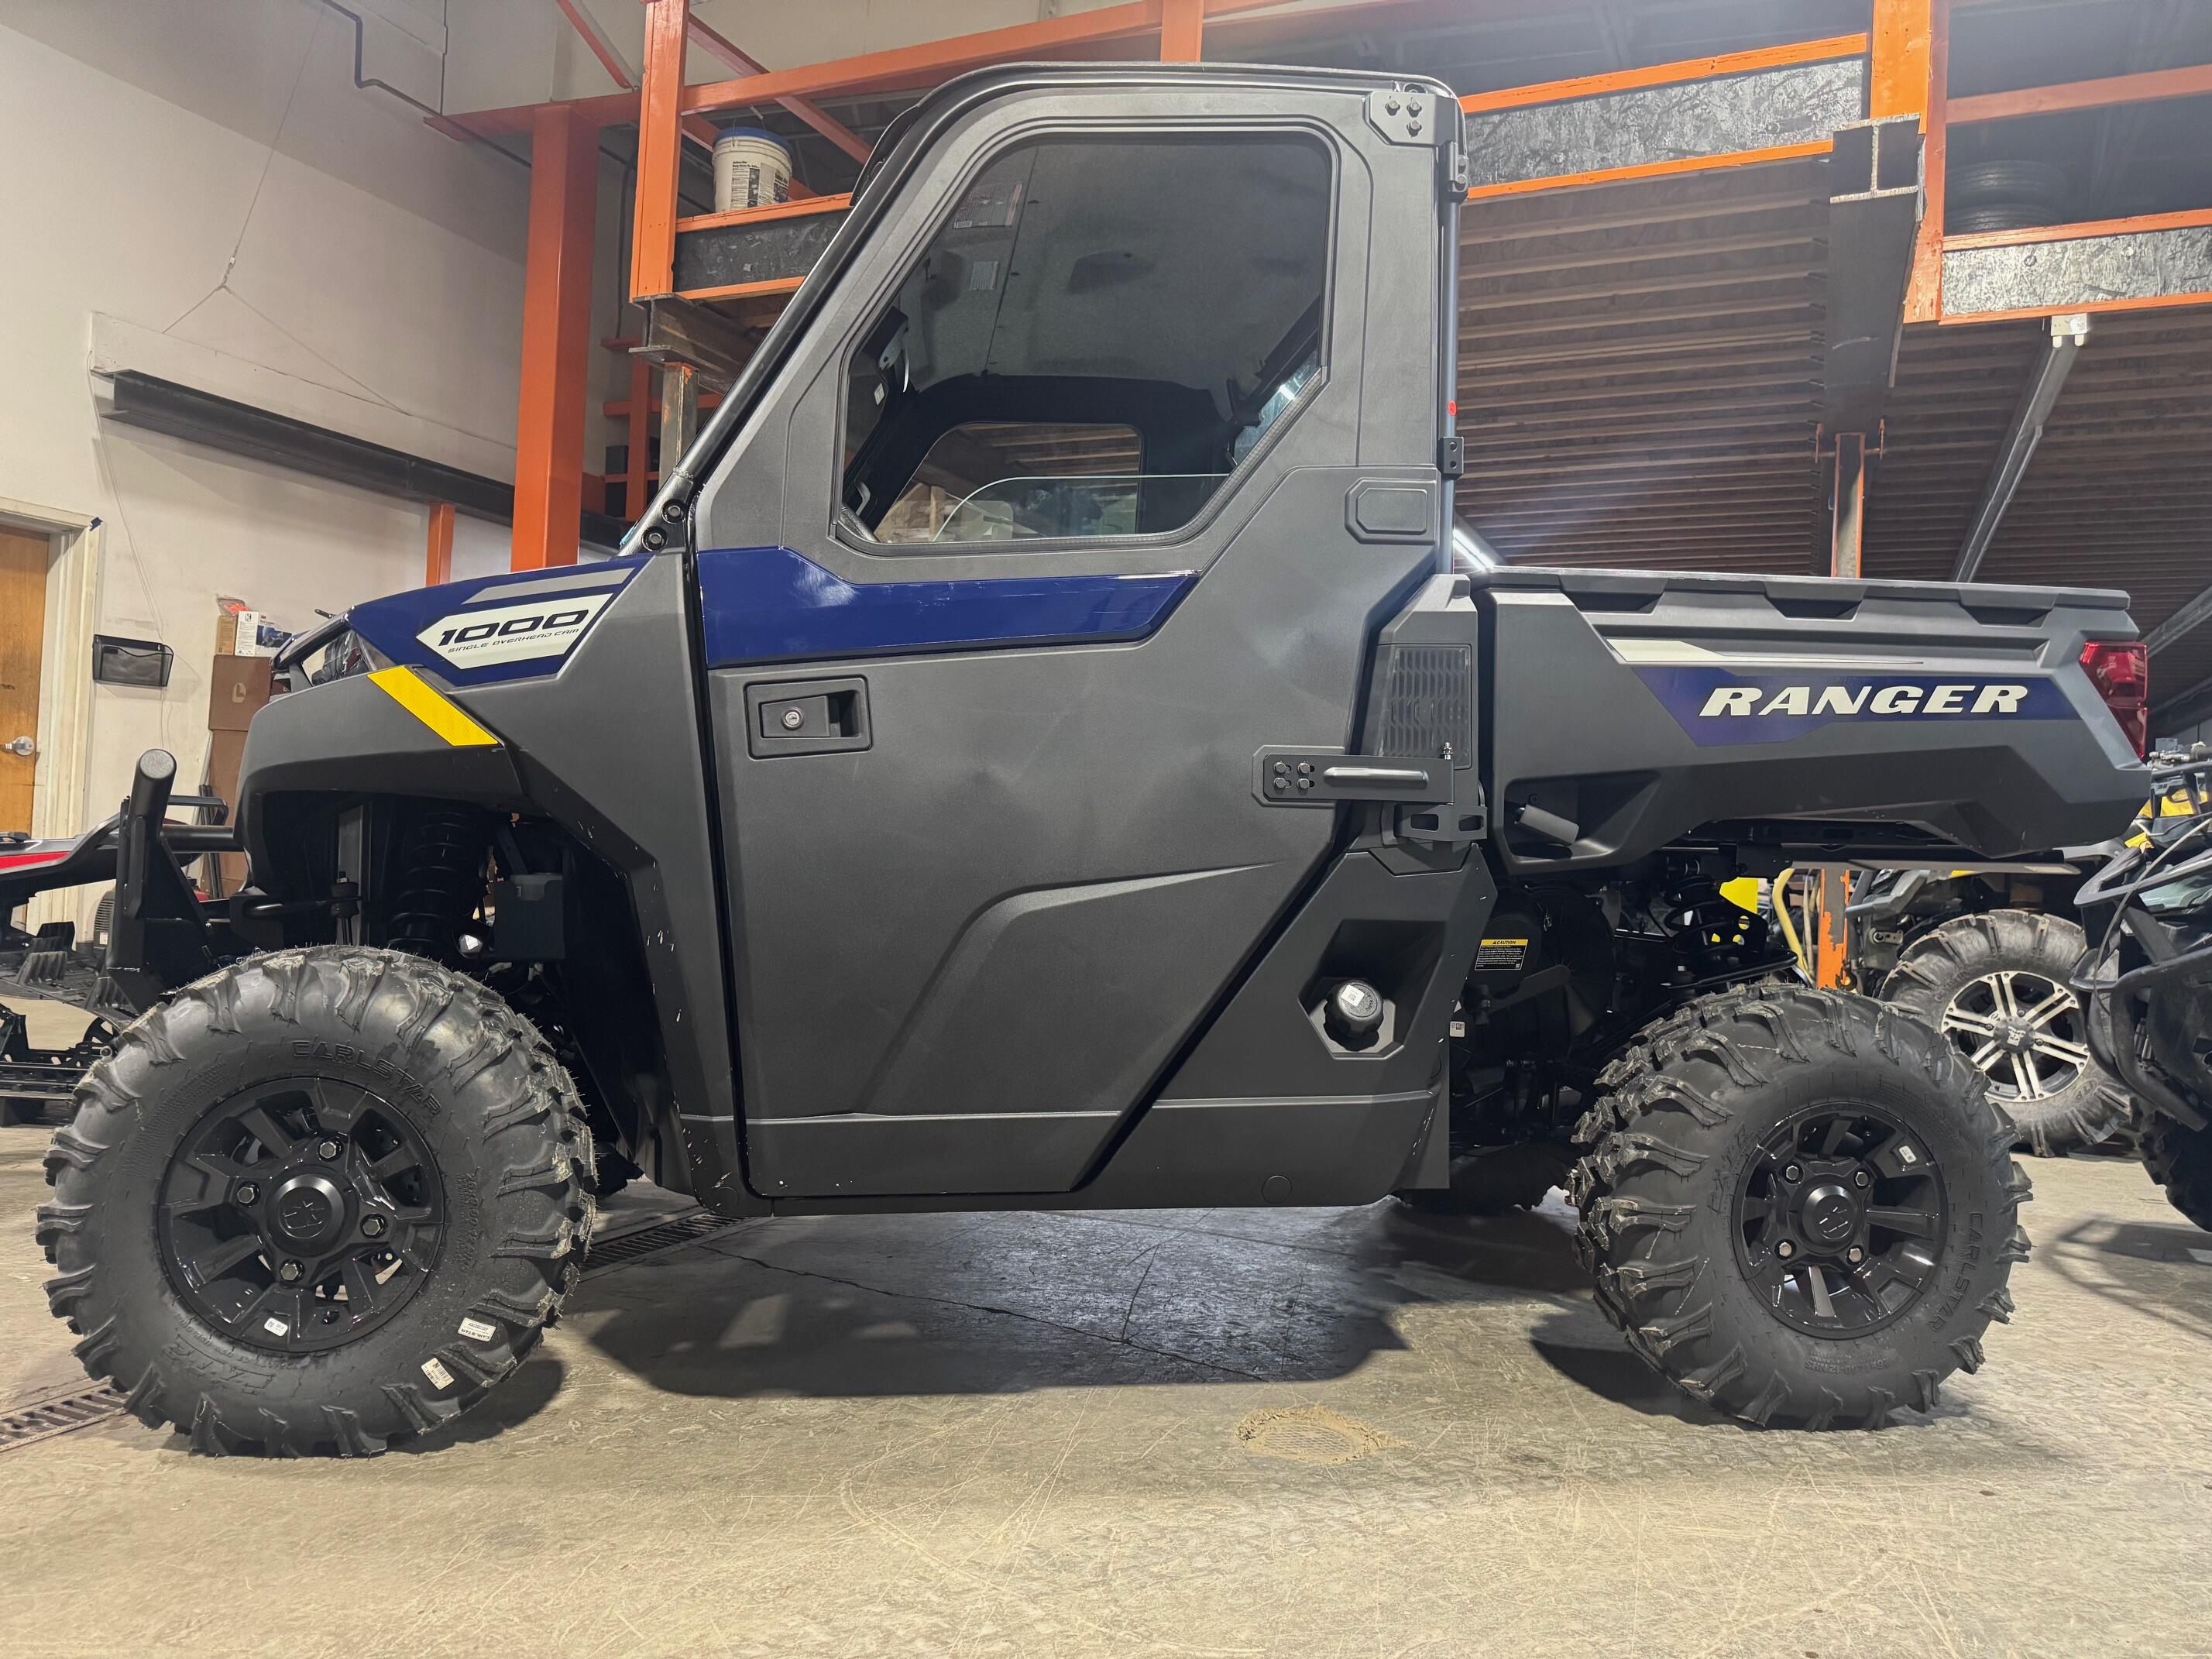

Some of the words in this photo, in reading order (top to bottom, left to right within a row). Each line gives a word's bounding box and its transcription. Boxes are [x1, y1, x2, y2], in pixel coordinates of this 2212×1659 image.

[438, 610, 589, 647] 1000
[448, 642, 489, 654] SINGLE
[493, 632, 552, 647] OVERHEAD
[554, 628, 579, 638] CAM
[1699, 685, 2028, 716] RANGER
[291, 1039, 442, 1116] CARLSTAR
[1926, 1211, 1984, 1333] CARLSTAR
[460, 1328, 490, 1340] CARLSTAR
